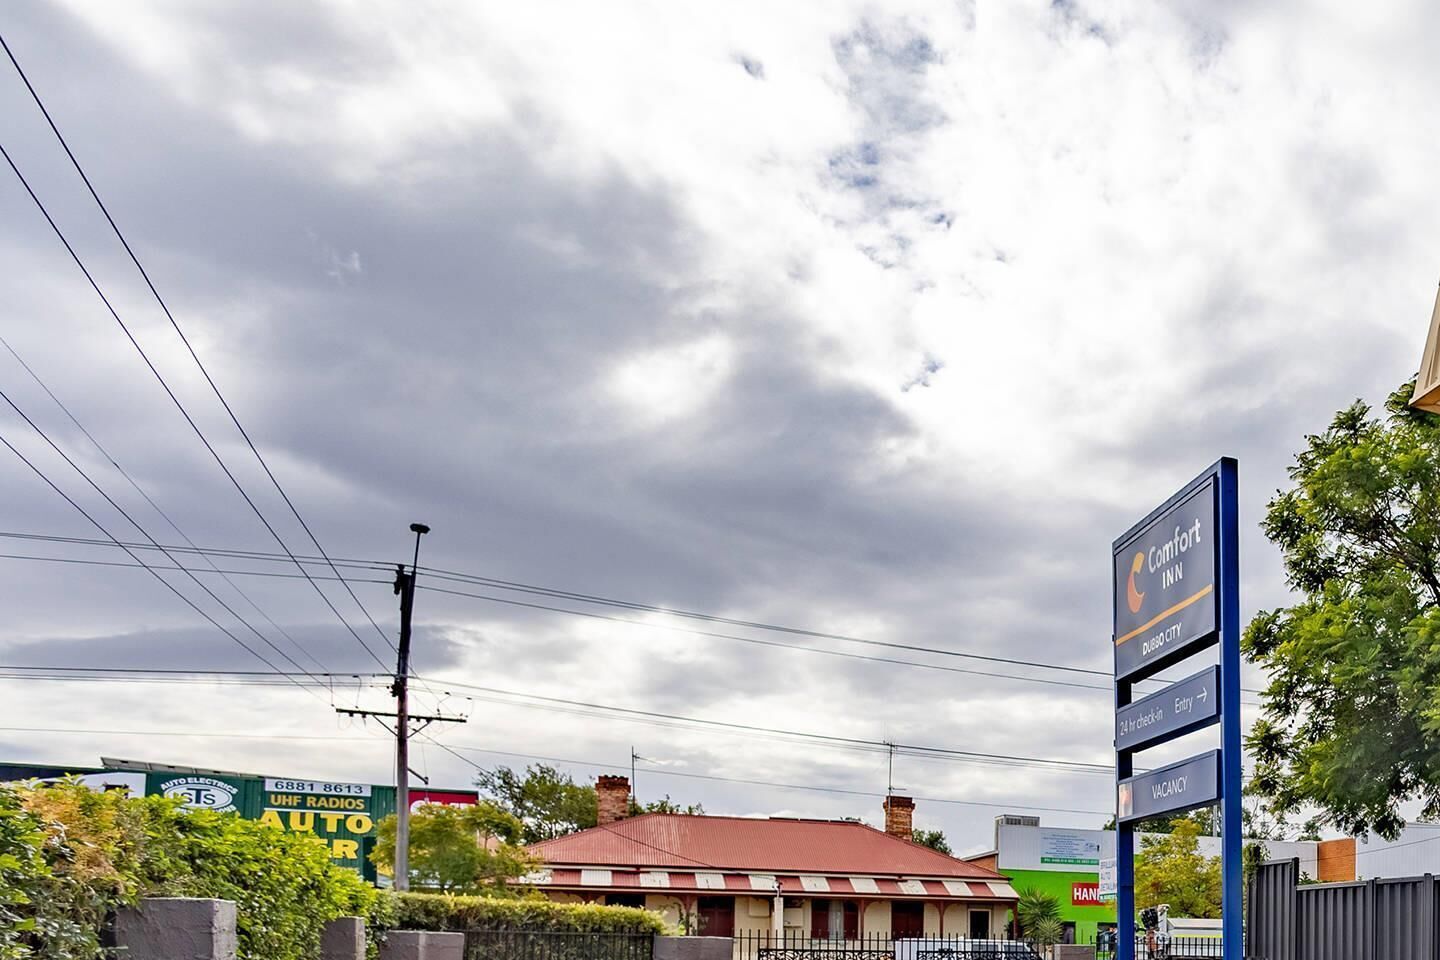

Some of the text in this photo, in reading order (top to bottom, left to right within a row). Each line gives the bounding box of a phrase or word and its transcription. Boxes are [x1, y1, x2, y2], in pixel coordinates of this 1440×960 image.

[1148, 518, 1201, 574] Comfort
[1162, 562, 1184, 590] INN
[1142, 622, 1182, 656] DUBBO CITY
[1119, 718, 1129, 737] 24
[1136, 709, 1163, 728] check-in
[1174, 696, 1194, 714] Entry
[160, 777, 239, 795] AUTO ELECTRICS
[274, 781, 363, 794] 6881 8613
[1152, 776, 1188, 799] VACANCY
[270, 794, 365, 810] UHF RADIOS
[260, 810, 373, 834] AUTO
